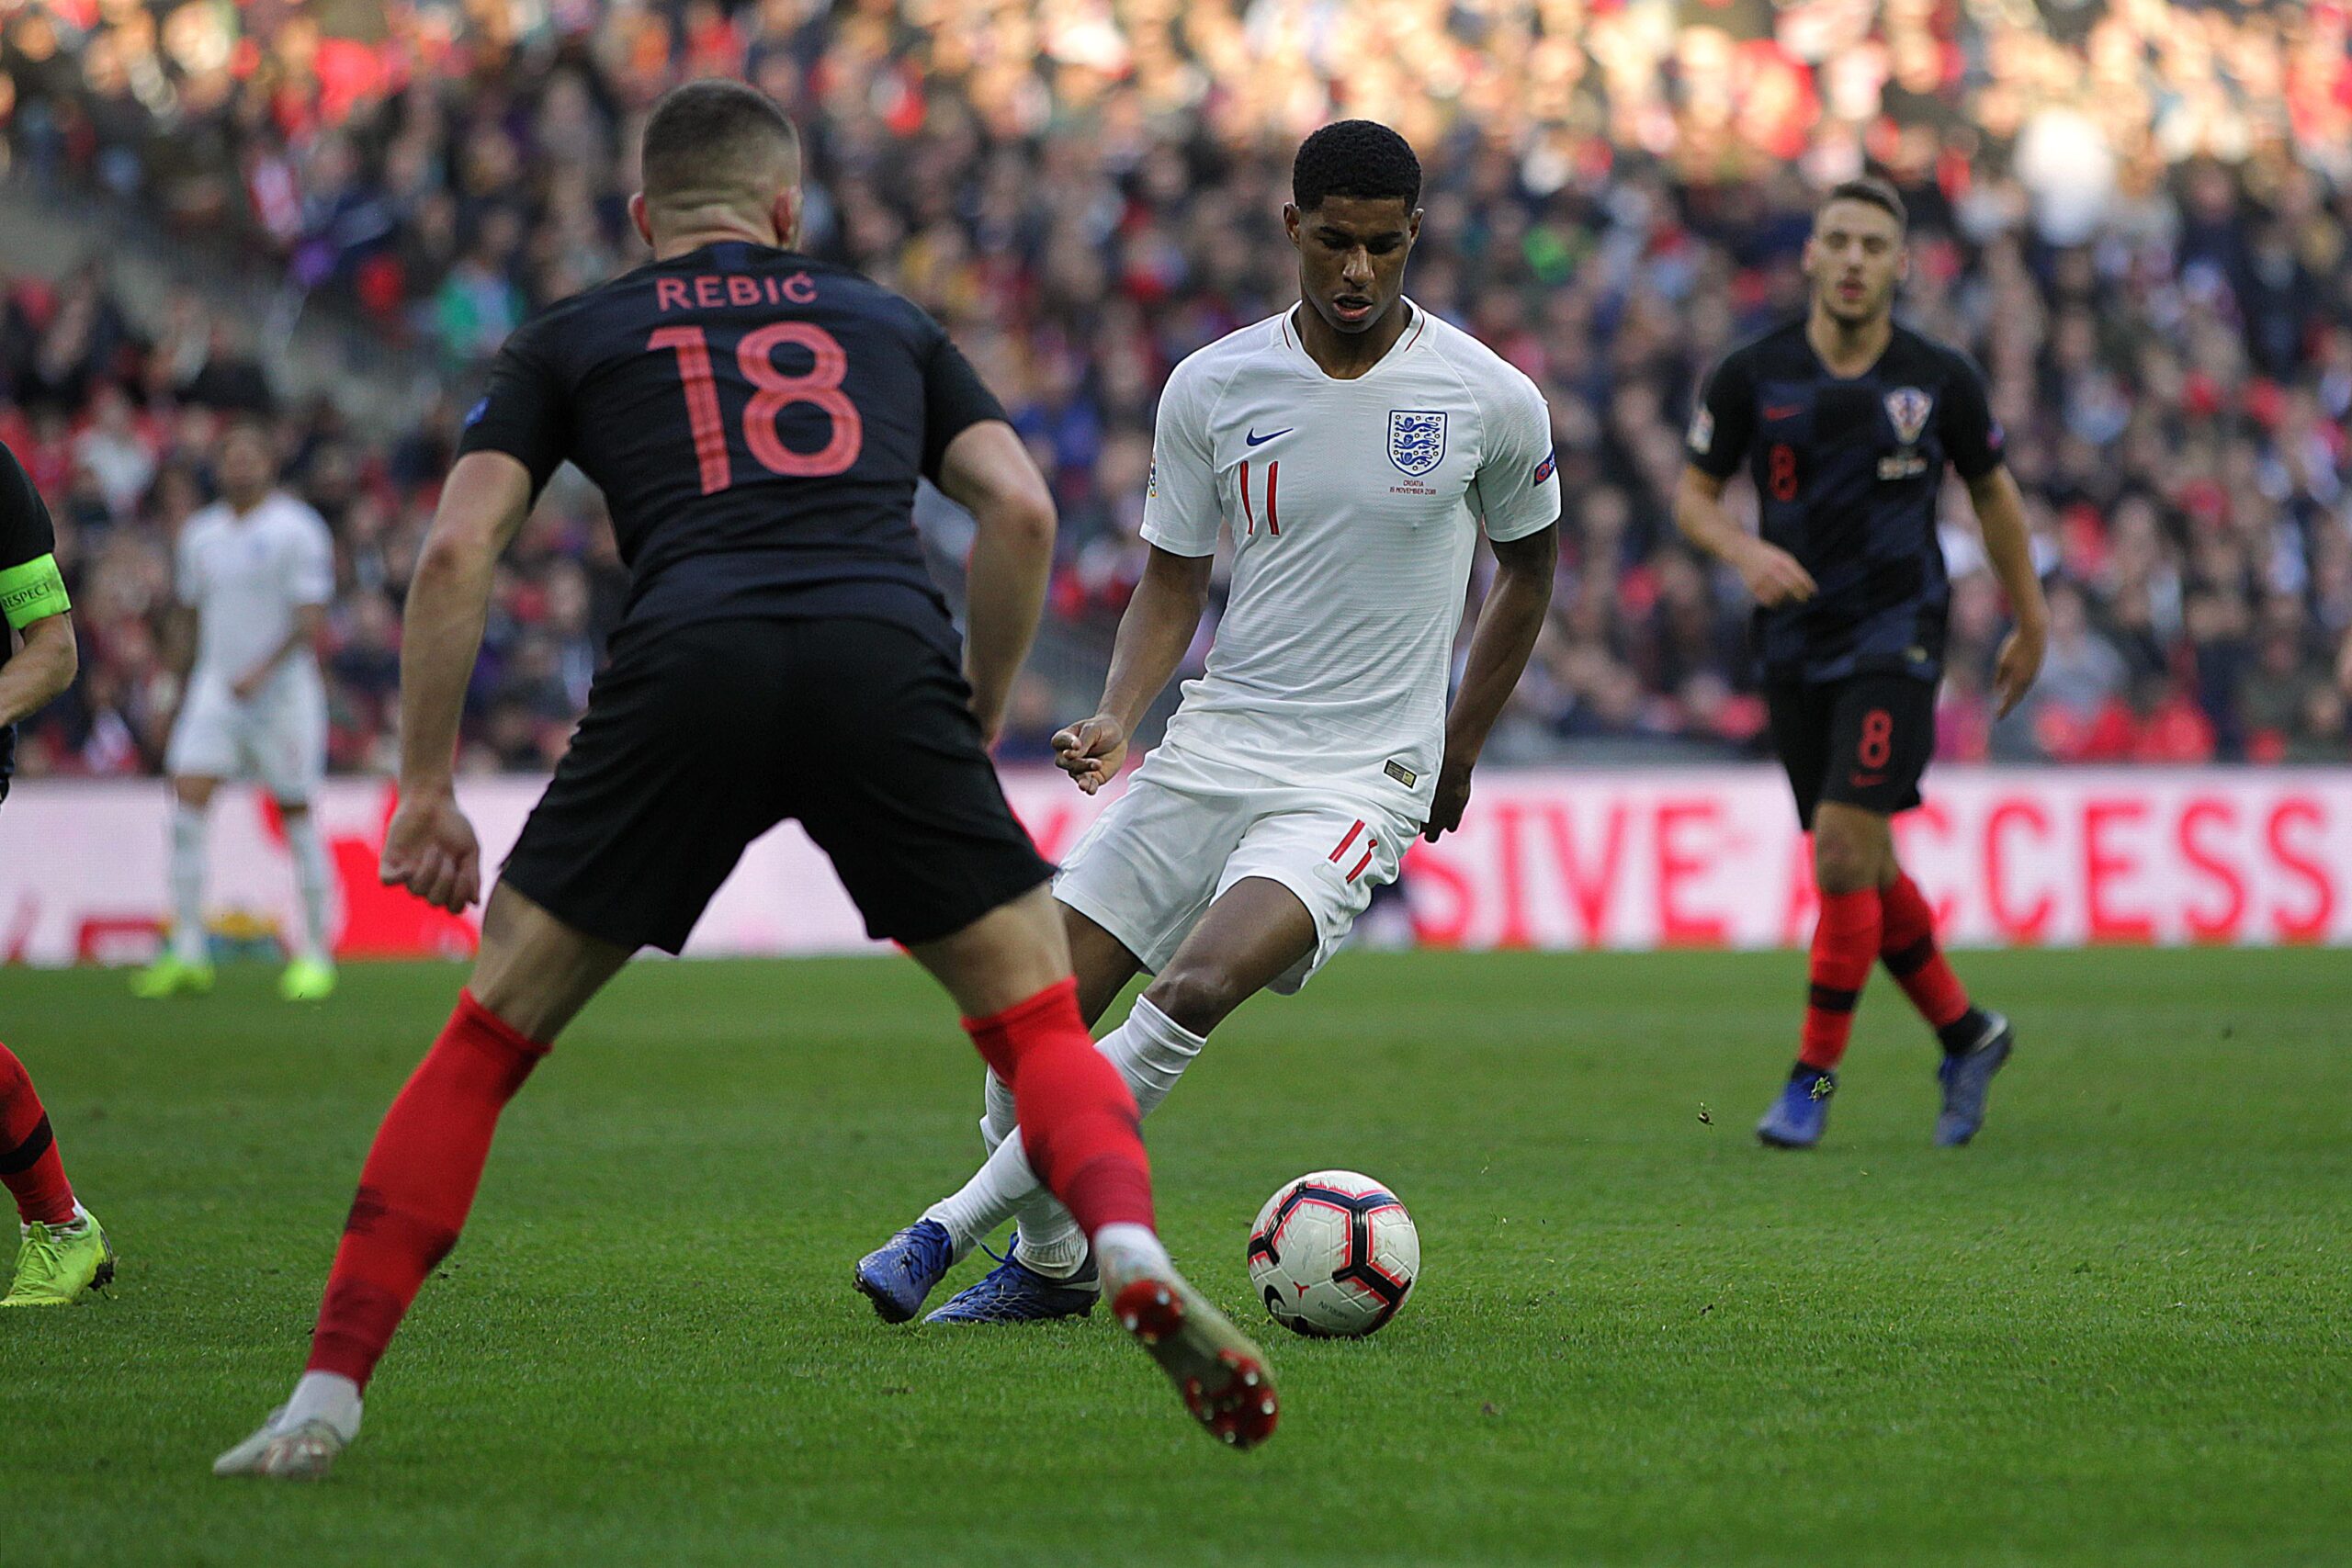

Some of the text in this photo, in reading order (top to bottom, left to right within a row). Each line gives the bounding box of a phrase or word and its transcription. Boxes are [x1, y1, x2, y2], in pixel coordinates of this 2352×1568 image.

[656, 271, 818, 312] REBIĆ
[646, 321, 863, 496] 18
[1239, 460, 1280, 536] 11
[1769, 443, 1798, 501] 8
[2, 581, 50, 610] RESPECT
[1859, 708, 1894, 769] 8
[1329, 818, 1378, 885] 11
